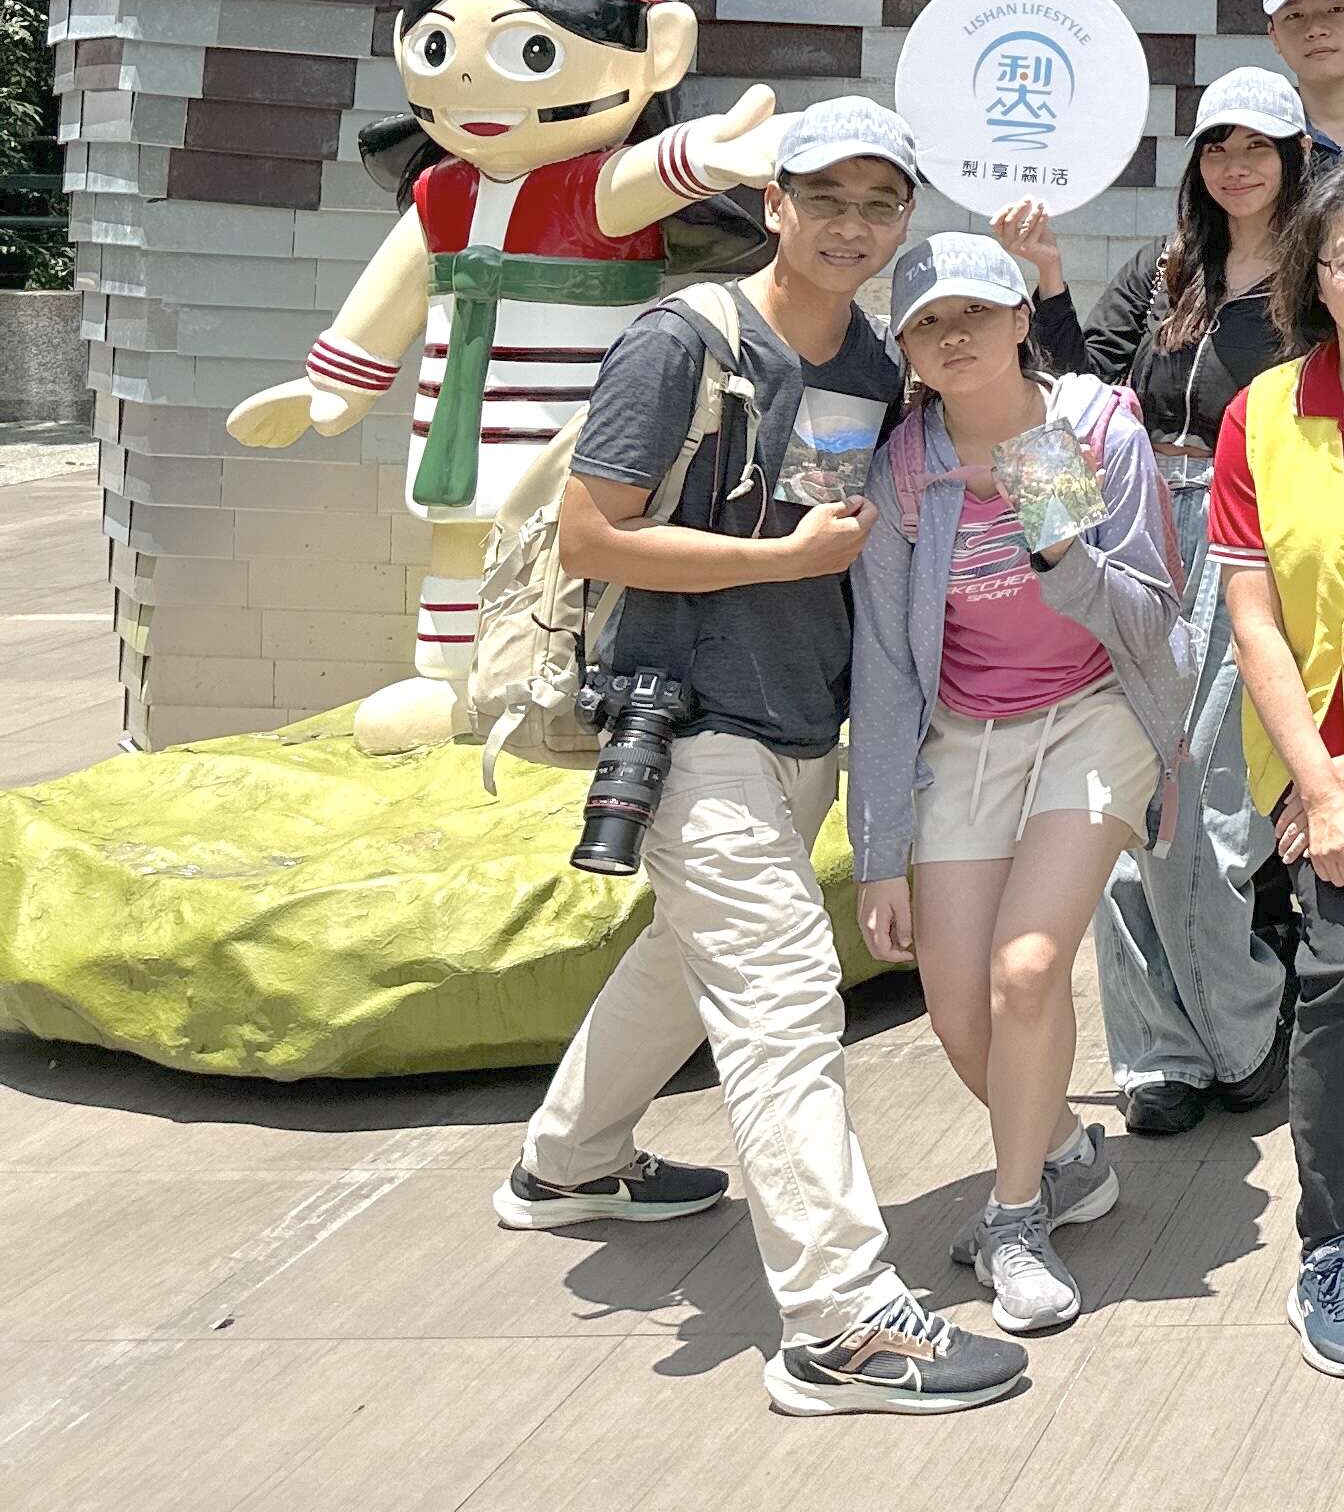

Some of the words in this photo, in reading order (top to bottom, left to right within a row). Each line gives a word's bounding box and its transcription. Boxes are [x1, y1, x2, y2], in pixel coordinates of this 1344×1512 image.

[963, 2, 1018, 36] LISHAN
[1022, 3, 1092, 46] LIFESTYLE
[950, 573, 1037, 595] KECHER
[966, 587, 1024, 602] SPORT
